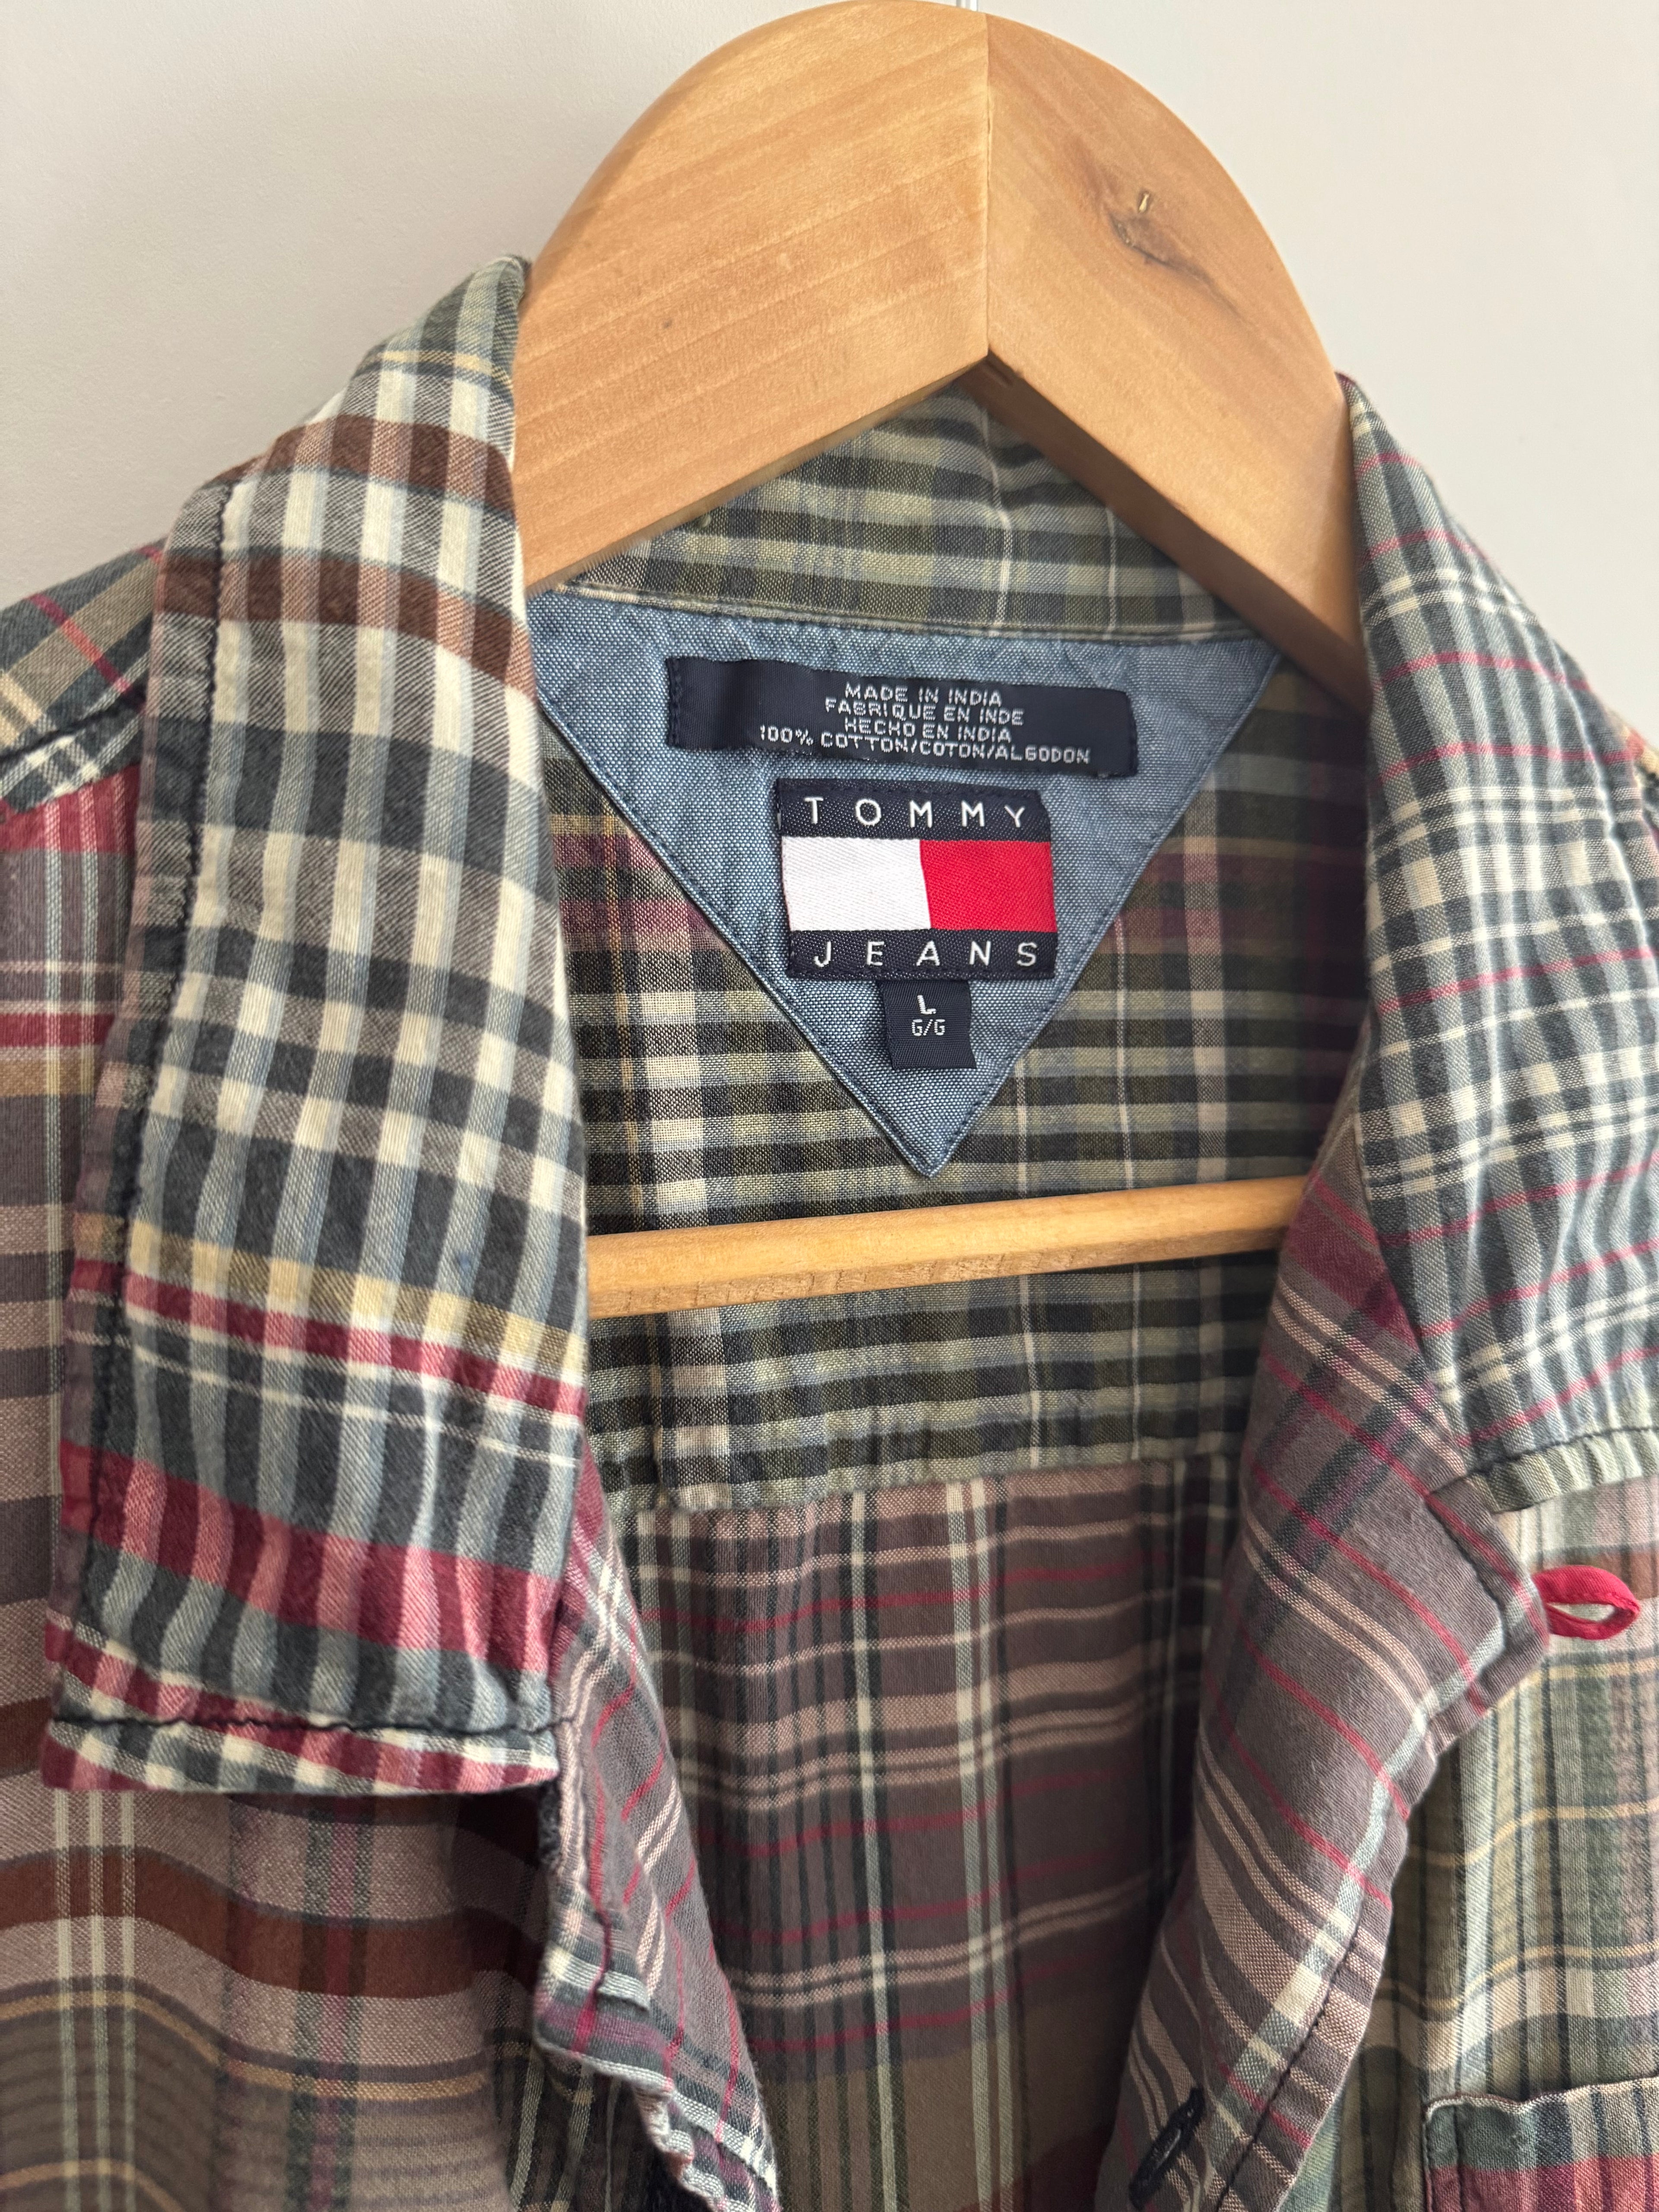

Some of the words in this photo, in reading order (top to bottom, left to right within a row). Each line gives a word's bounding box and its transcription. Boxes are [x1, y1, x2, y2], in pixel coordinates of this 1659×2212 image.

[845, 681, 908, 702] MADE
[918, 686, 939, 704] IN
[948, 687, 1002, 707] INDIA
[825, 696, 936, 721] FABRIQUE
[944, 705, 970, 723] EN
[979, 707, 1025, 726] INDE
[845, 716, 916, 737] HECHO
[922, 722, 949, 741] EN
[957, 725, 1012, 744] INDIA
[760, 724, 814, 746] 100%
[820, 731, 1091, 765] COTTON/COTON/ALGODON
[804, 797, 1026, 828] TOMMY
[814, 941, 1038, 967] JEANS
[917, 995, 937, 1015] L
[911, 1018, 946, 1037] G/G
